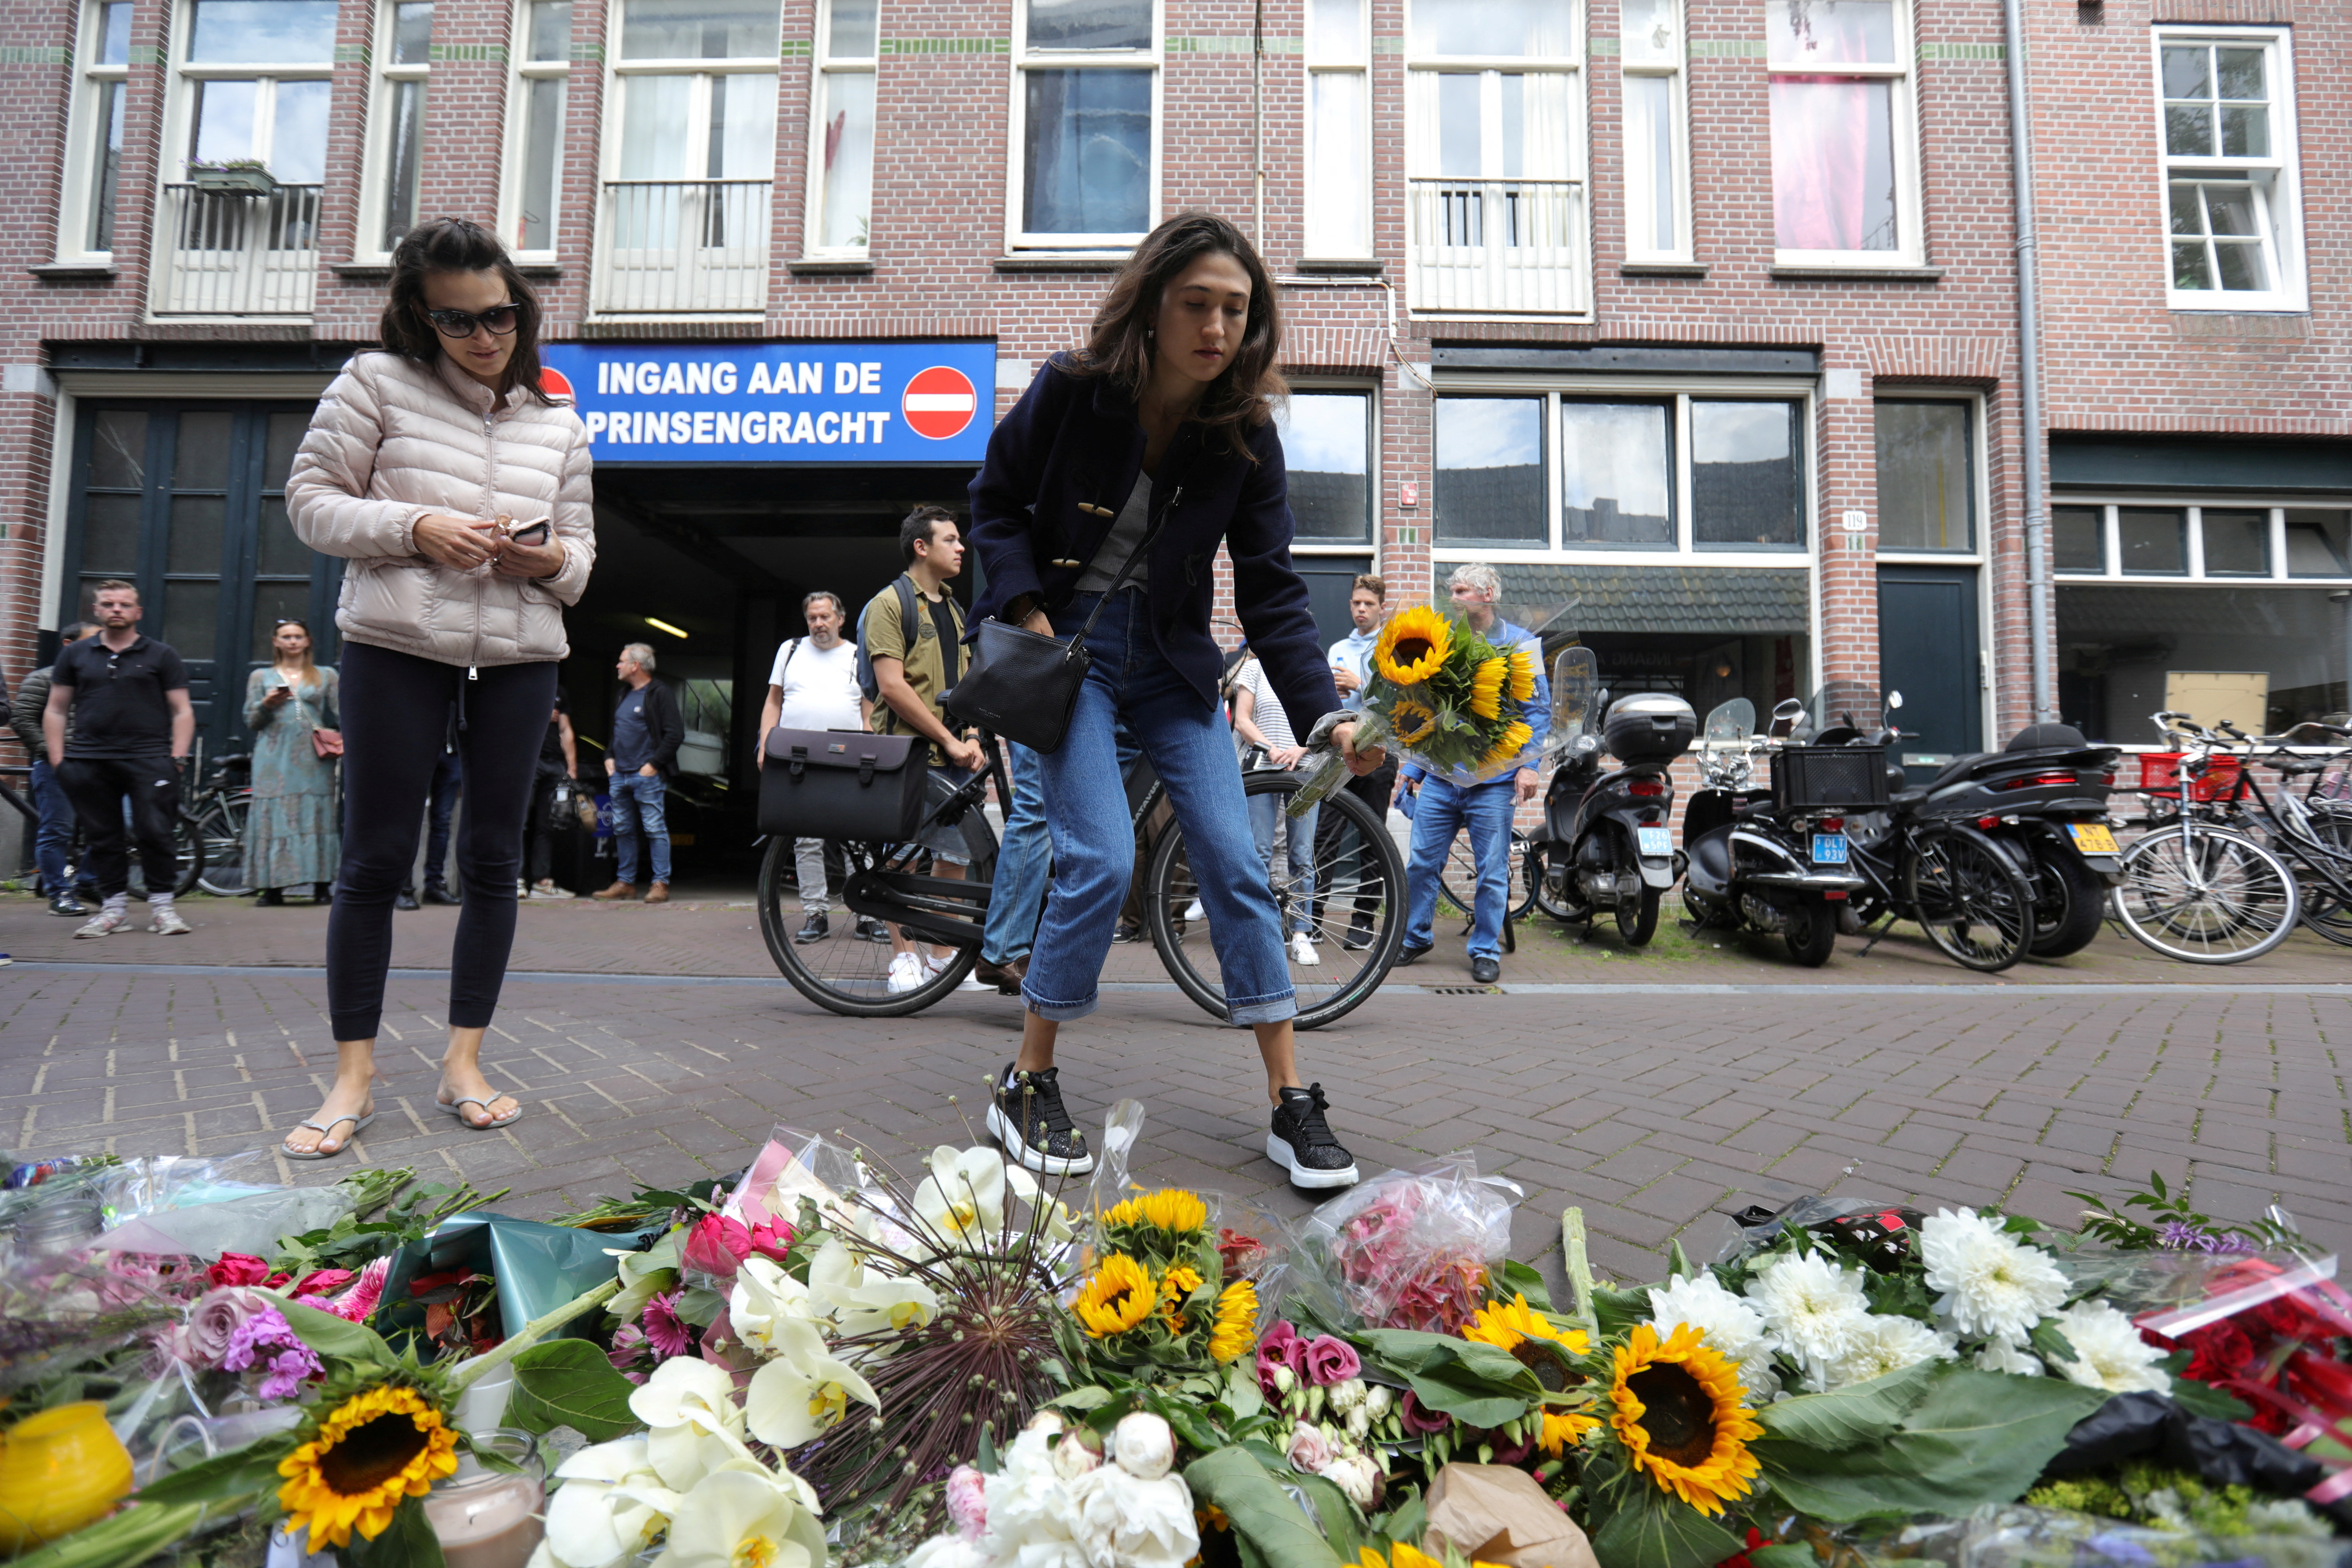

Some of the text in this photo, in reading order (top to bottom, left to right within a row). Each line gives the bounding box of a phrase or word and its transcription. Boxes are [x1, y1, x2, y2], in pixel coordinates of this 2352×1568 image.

[598, 362, 881, 394] INGANG AAN DE
[587, 411, 890, 444] PRINSENGRACHT
[1847, 514, 1862, 527] 119
[1649, 831, 1668, 840] F26
[2083, 826, 2100, 837] NT
[1651, 841, 1668, 850] 5PF
[1824, 838, 1845, 848] DLT
[1824, 849, 1844, 860] 93V
